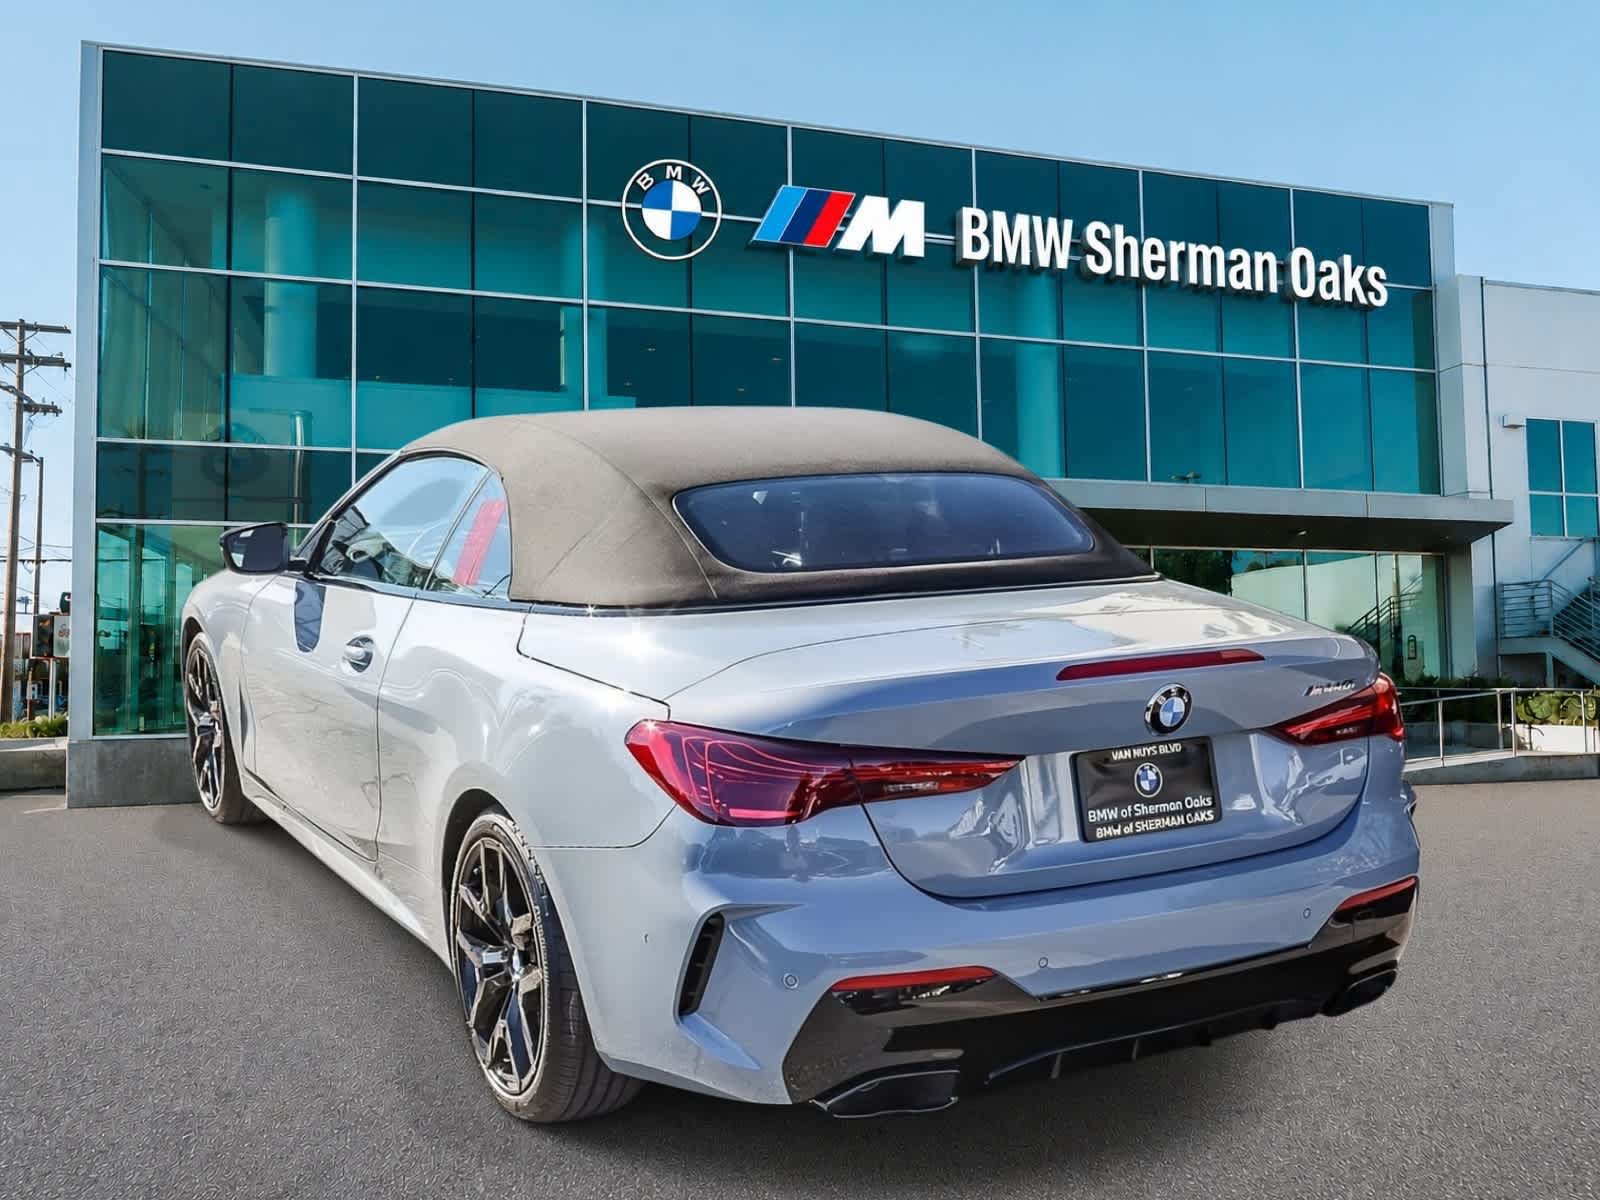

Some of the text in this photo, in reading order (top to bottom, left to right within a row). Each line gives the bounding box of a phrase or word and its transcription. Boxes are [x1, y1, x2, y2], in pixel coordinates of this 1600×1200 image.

[635, 164, 712, 196] BMW
[960, 206, 1389, 308] BMW Sherman Oaks
[1112, 743, 1182, 760] VAN NUYS BLVD
[1088, 795, 1213, 823] BMW of Sherman Oaks
[1096, 810, 1215, 839] BMW of SHERMAN OAKS
